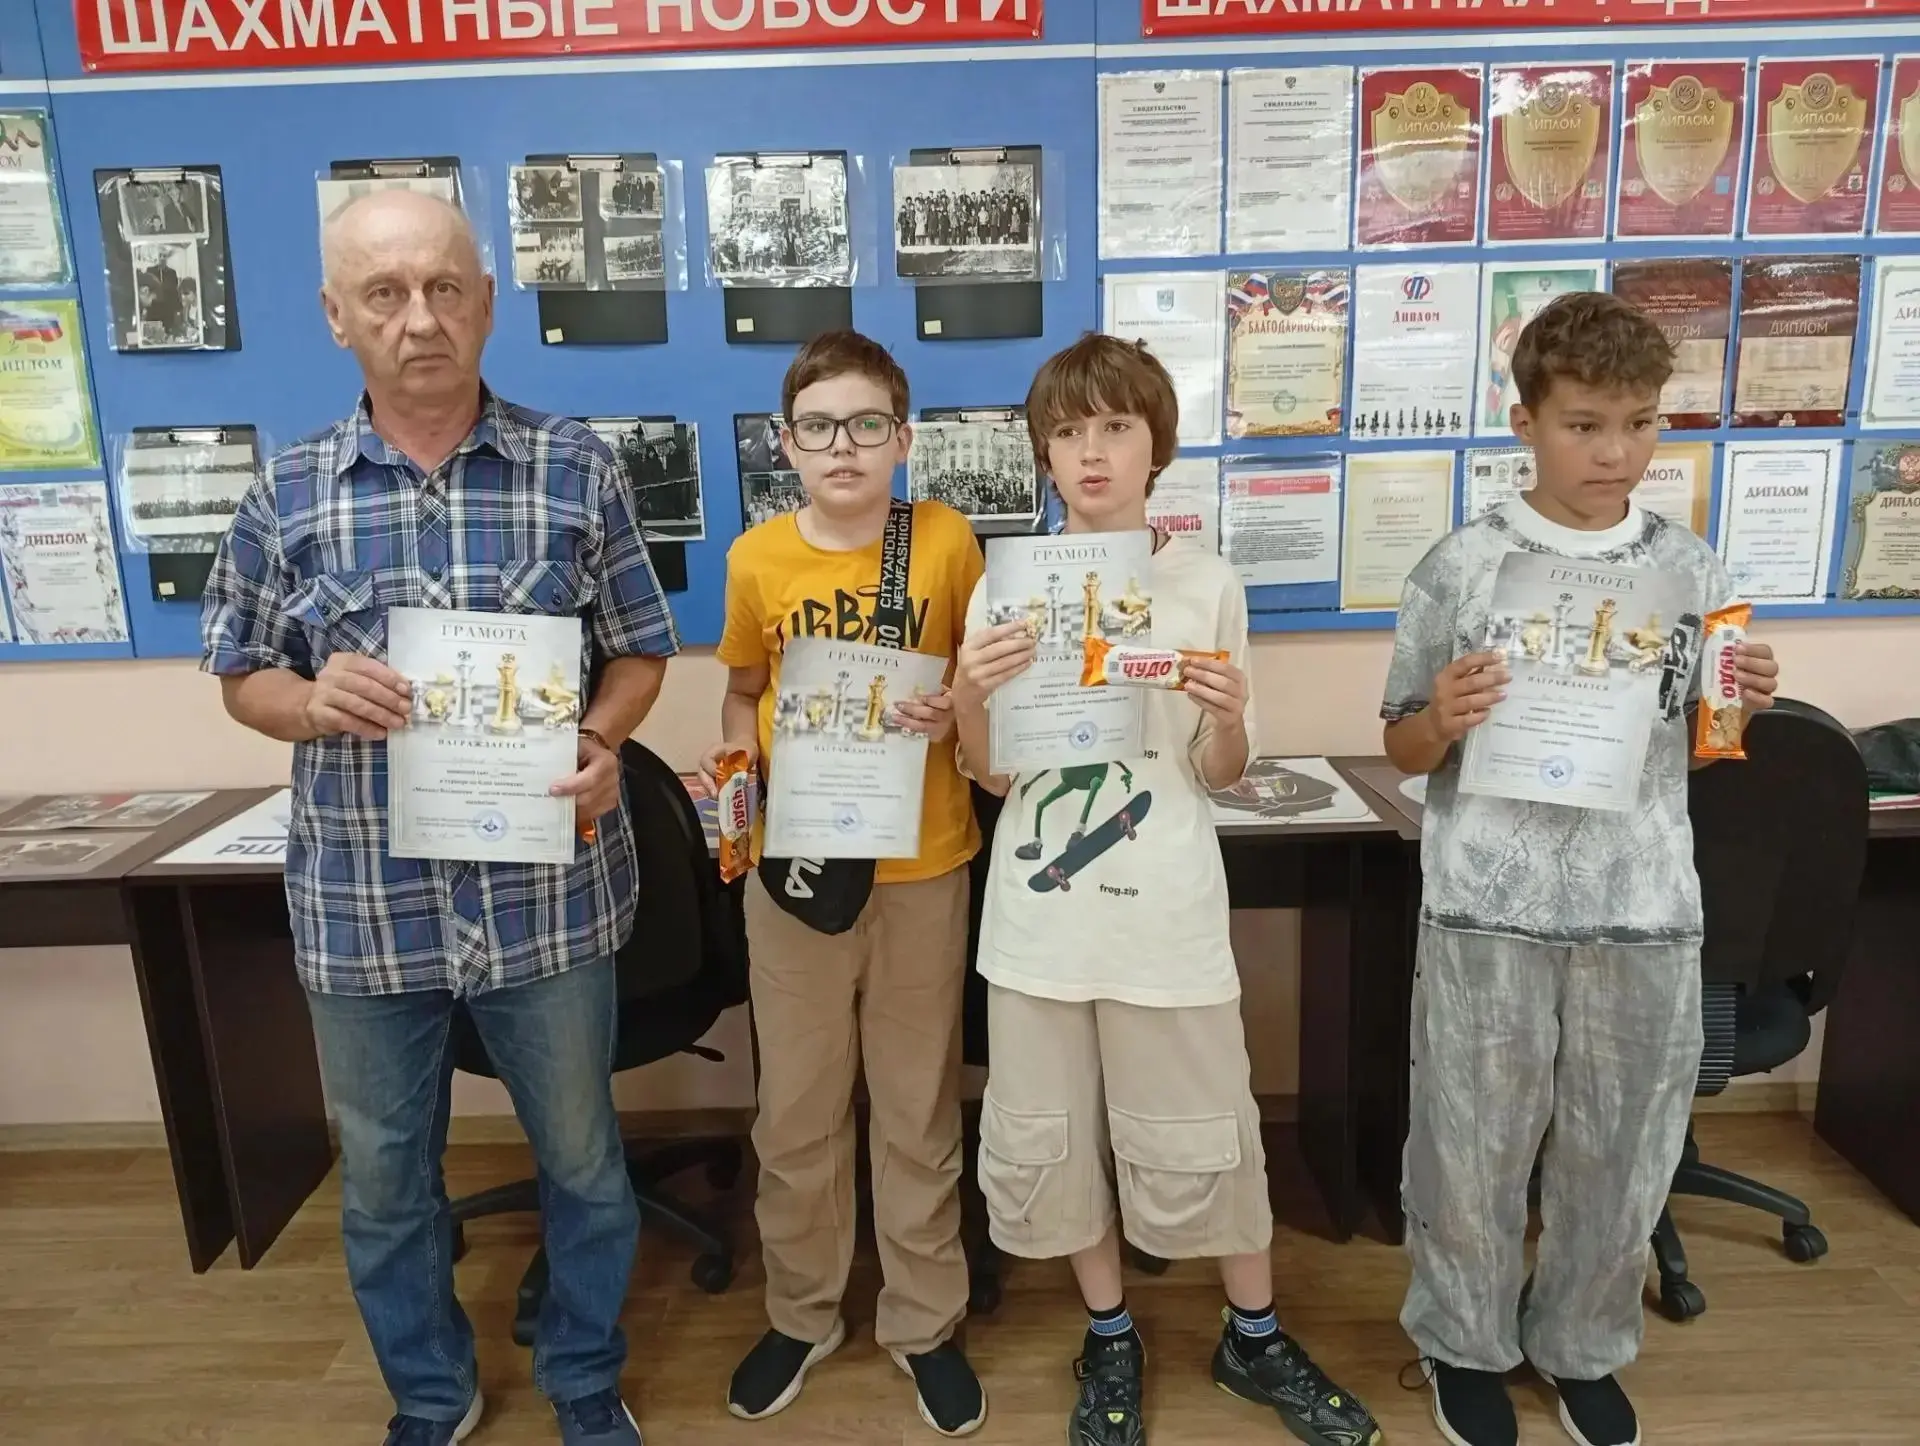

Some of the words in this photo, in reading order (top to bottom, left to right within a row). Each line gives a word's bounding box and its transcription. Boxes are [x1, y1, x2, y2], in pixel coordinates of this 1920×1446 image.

[97, 0, 619, 54] ШАХМАТНЫЕ
[1768, 320, 1829, 335] ДИПЛОМ
[1744, 485, 1809, 499] ДИПЛОМ
[24, 532, 89, 549] ДИПЛОМ
[880, 512, 898, 609] CITYANDLIFE
[892, 512, 911, 611] NEWFASHION
[1033, 546, 1109, 562] ГРАМОТА
[1550, 568, 1634, 591] ГРАМОТА
[440, 624, 528, 641] ГРАМОТА
[828, 650, 900, 668] ГРАМОТА
[1123, 660, 1173, 678] ЧУДО
[438, 737, 527, 749] НАГРАЖДАЕТСЯ
[732, 788, 746, 829] ЧУДО
[1099, 883, 1139, 897] frog.zip
